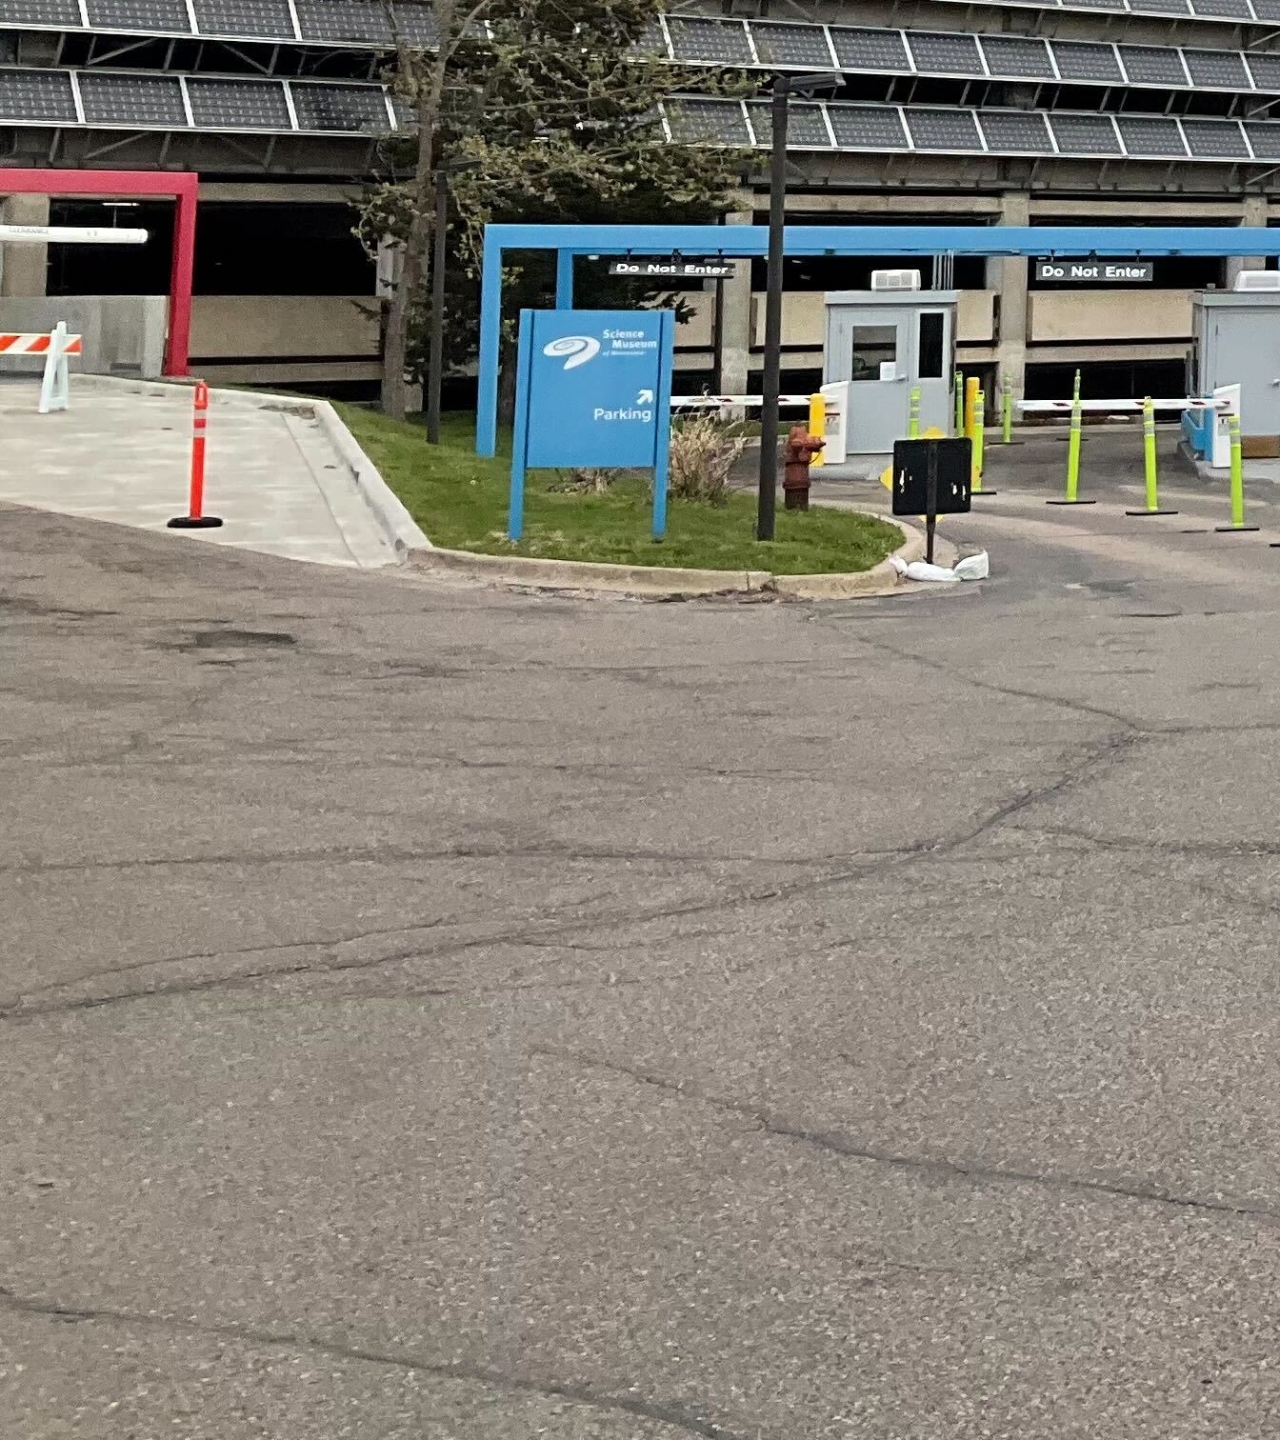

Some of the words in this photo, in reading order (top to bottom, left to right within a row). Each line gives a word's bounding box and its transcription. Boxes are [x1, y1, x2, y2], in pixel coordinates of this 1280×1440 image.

[616, 263, 640, 273] Do
[647, 264, 676, 273] Not
[684, 265, 728, 274] Enter
[1042, 266, 1065, 277] Do
[1071, 266, 1099, 277] Not
[1105, 266, 1147, 277] Enter
[602, 329, 644, 339] Science
[612, 339, 657, 349] Museum
[593, 408, 652, 423] Parking
